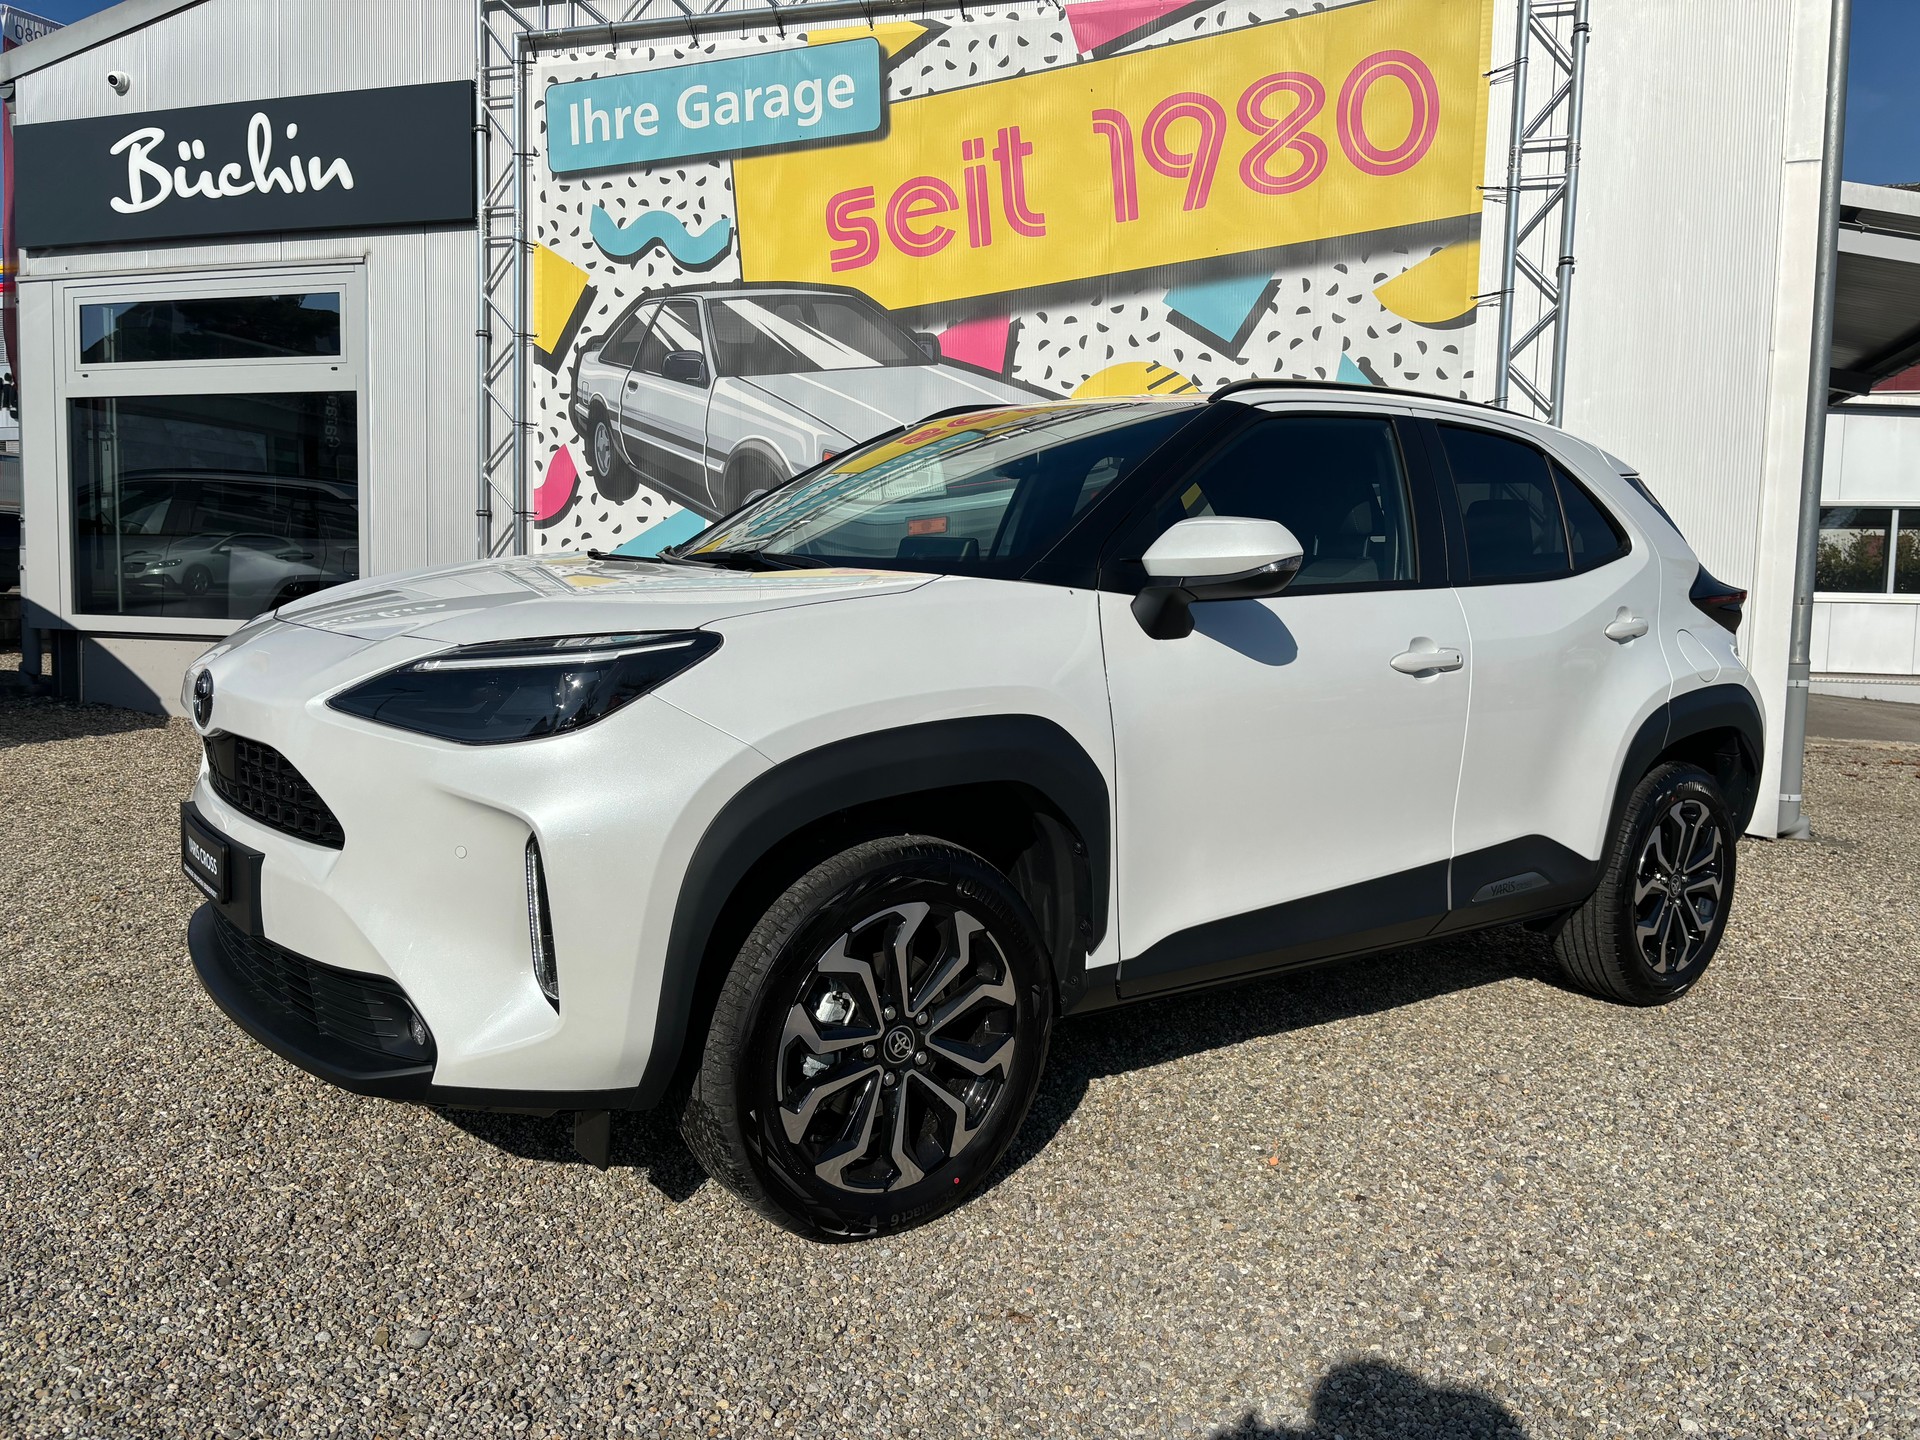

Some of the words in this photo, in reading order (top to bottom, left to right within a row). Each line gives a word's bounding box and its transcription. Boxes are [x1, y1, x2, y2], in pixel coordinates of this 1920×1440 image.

[569, 98, 660, 146] Ihre
[676, 73, 856, 129] Garage
[825, 126, 1046, 272] seit
[1092, 49, 1440, 224] 1980
[110, 112, 354, 214] Büchin
